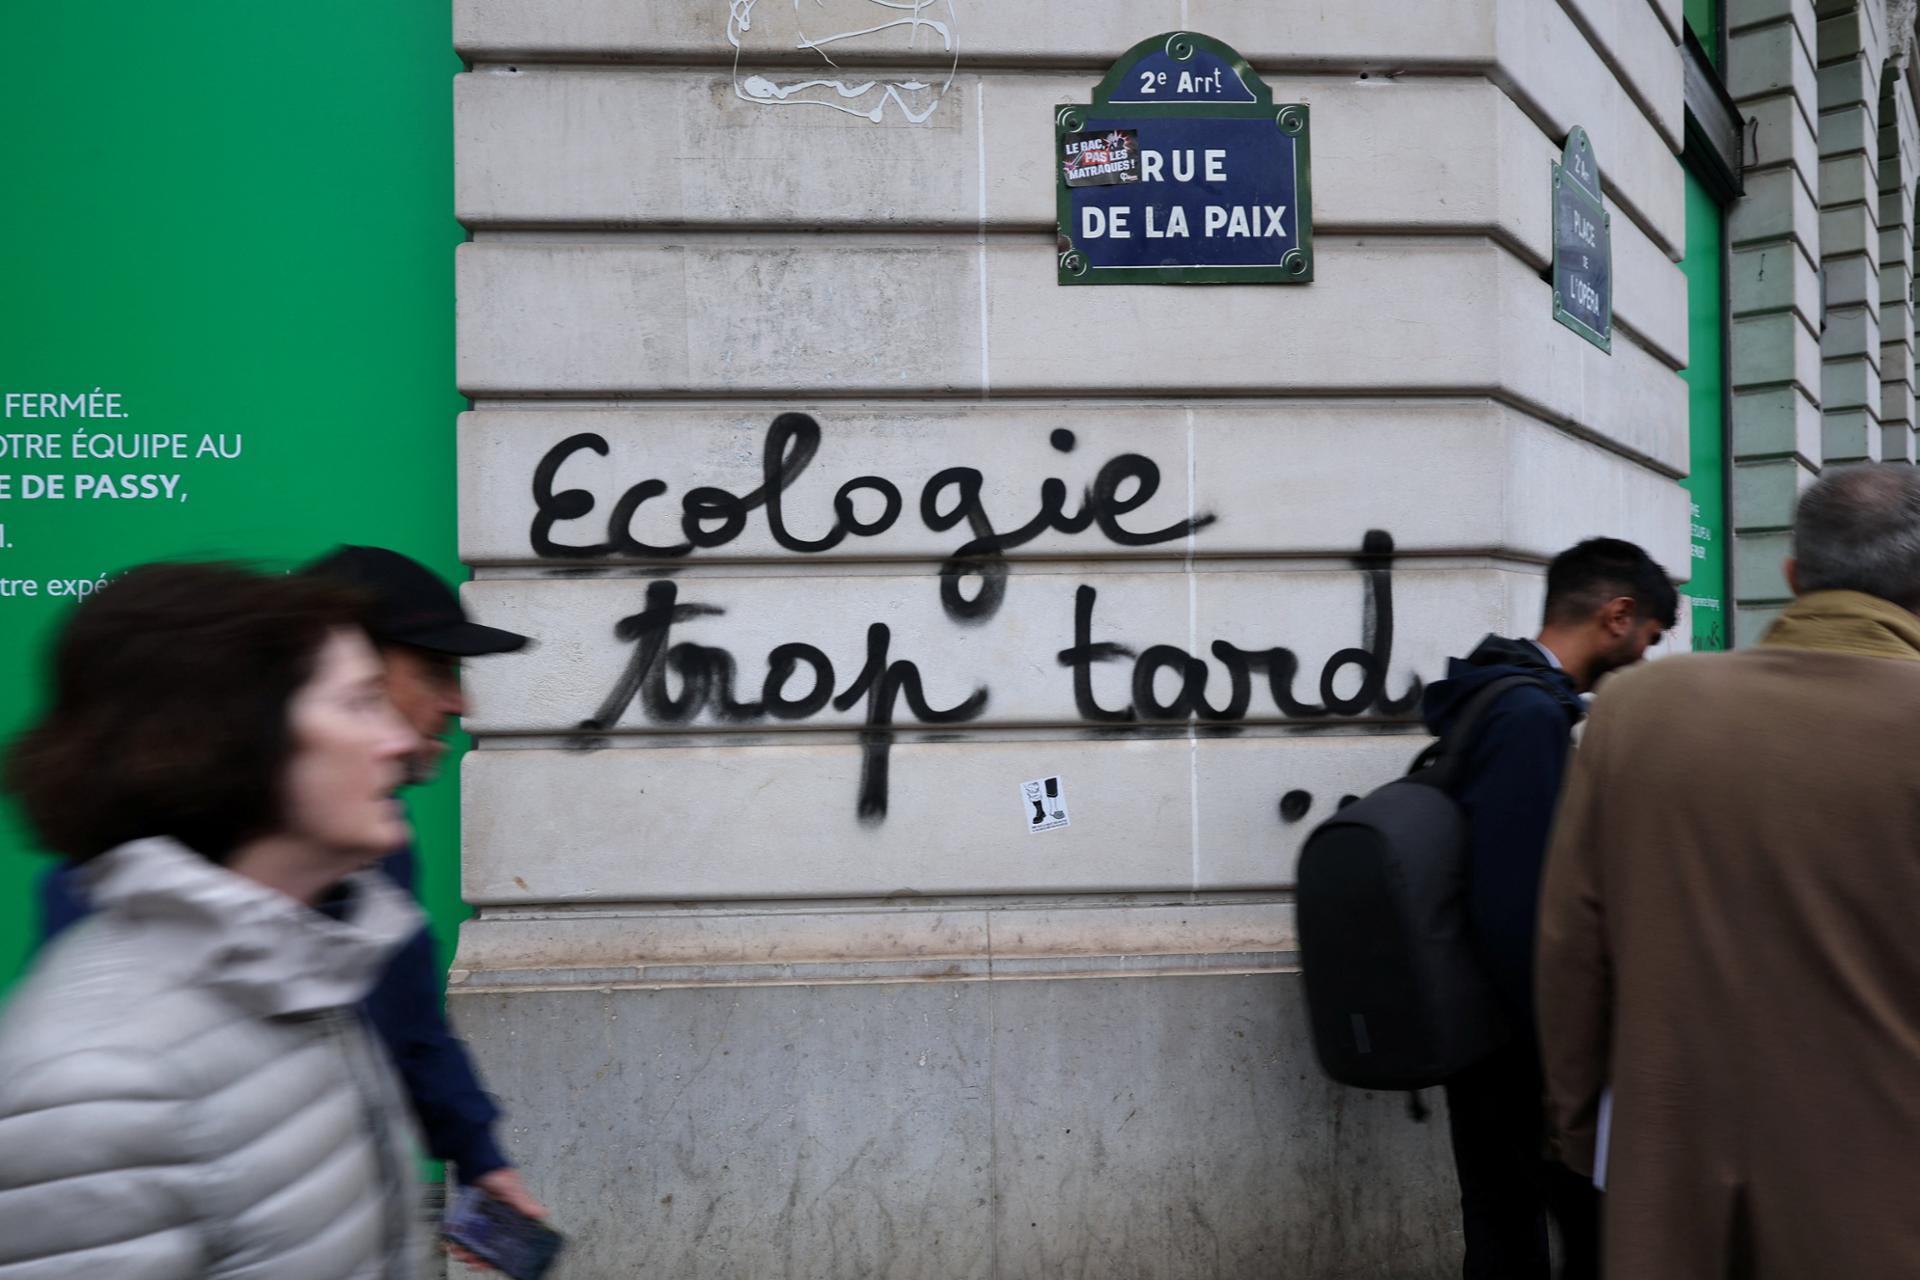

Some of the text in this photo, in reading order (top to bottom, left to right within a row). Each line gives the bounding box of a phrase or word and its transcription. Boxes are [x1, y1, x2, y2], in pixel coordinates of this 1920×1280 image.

[1066, 143, 1079, 155] LE
[1085, 149, 1128, 163] PAS LES
[1141, 150, 1228, 182] RUE
[1081, 205, 1287, 239] DE LA PAIX
[5, 386, 129, 418] FERMÉE.
[72, 427, 188, 459] ÉQUIPE
[196, 433, 242, 459] AU
[22, 474, 65, 499] DE
[75, 473, 188, 503] PASSY,
[530, 412, 1216, 626] Ecologie
[47, 572, 113, 604] expé
[568, 528, 1423, 826] trop tard
